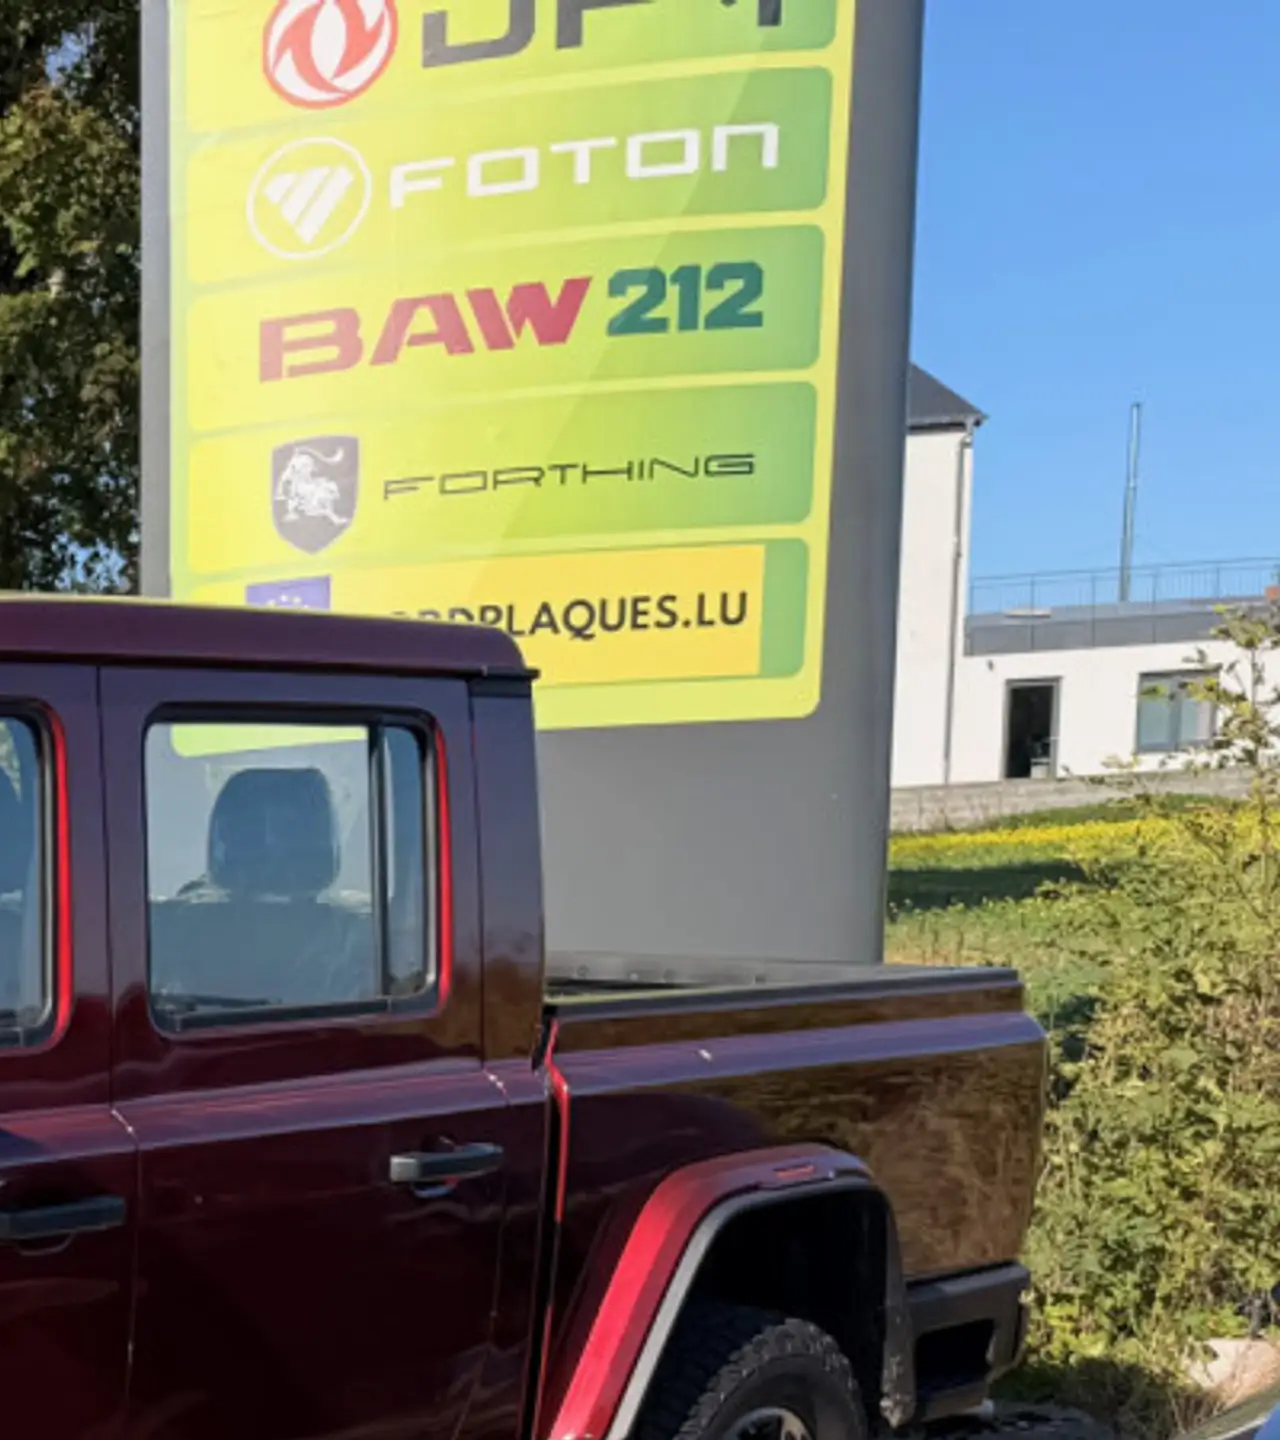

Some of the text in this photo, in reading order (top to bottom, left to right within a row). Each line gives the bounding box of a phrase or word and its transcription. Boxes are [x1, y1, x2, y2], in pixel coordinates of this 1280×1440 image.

[389, 122, 780, 209] FOTON
[258, 261, 764, 382] BAW 212
[383, 454, 757, 500] FORTHING
